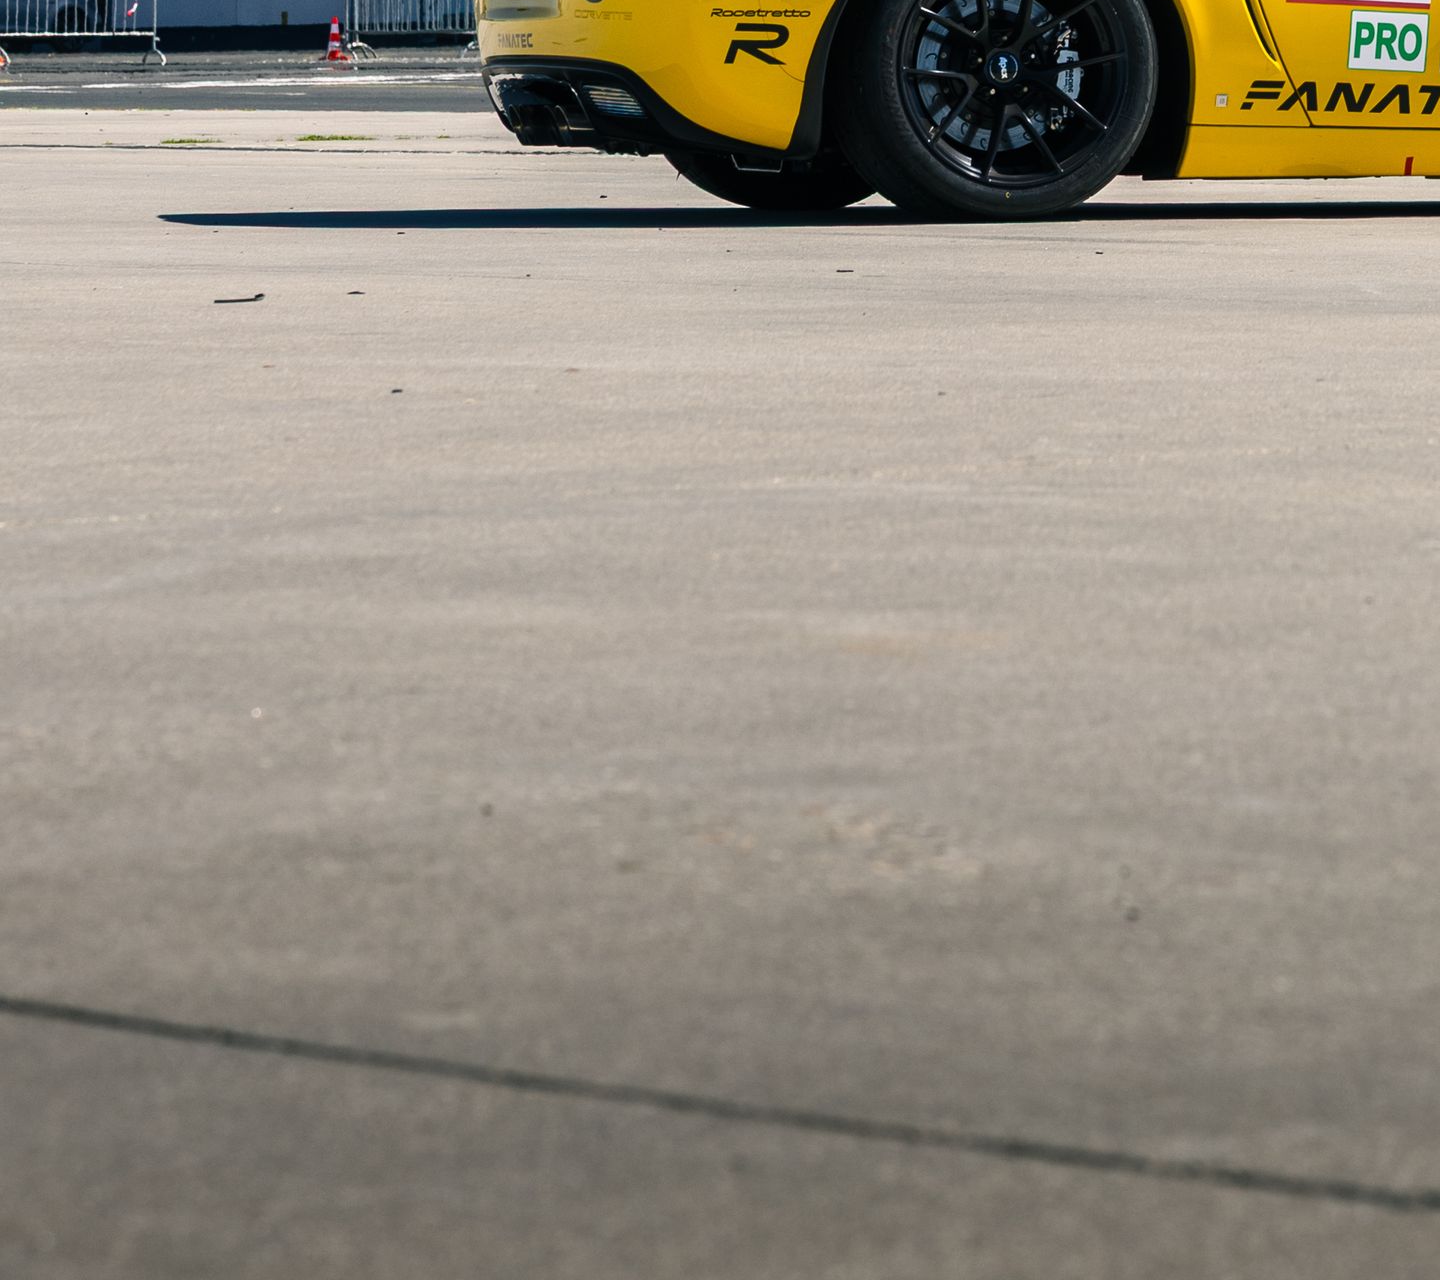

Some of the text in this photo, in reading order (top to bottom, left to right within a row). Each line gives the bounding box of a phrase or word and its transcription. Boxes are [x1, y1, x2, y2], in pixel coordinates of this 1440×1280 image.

[574, 9, 633, 21] CORVETTE
[724, 22, 790, 65] R
[1352, 21, 1423, 62] PRO
